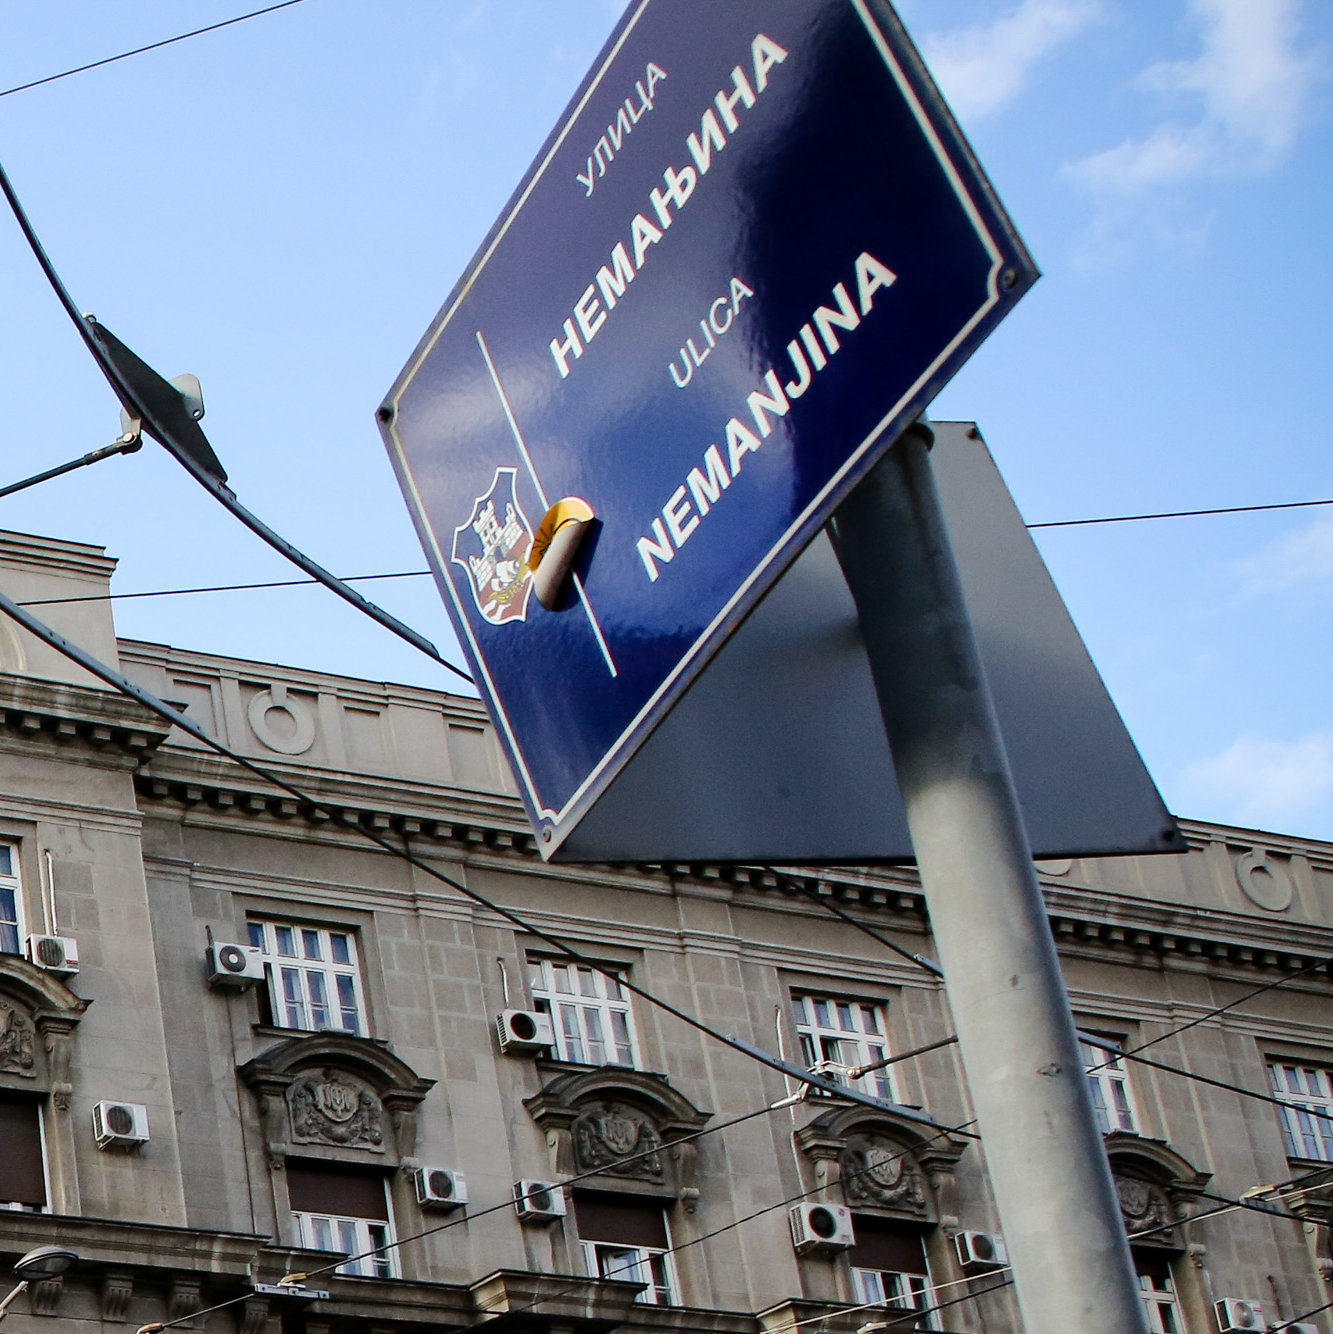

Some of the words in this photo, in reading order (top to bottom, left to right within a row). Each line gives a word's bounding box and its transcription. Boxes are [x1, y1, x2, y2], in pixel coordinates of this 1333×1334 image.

[549, 33, 788, 379] НЕМАЊИНА
[576, 62, 667, 197] УЛИЦА
[636, 252, 897, 582] NEMANJINA
[669, 277, 755, 389] ULICA
